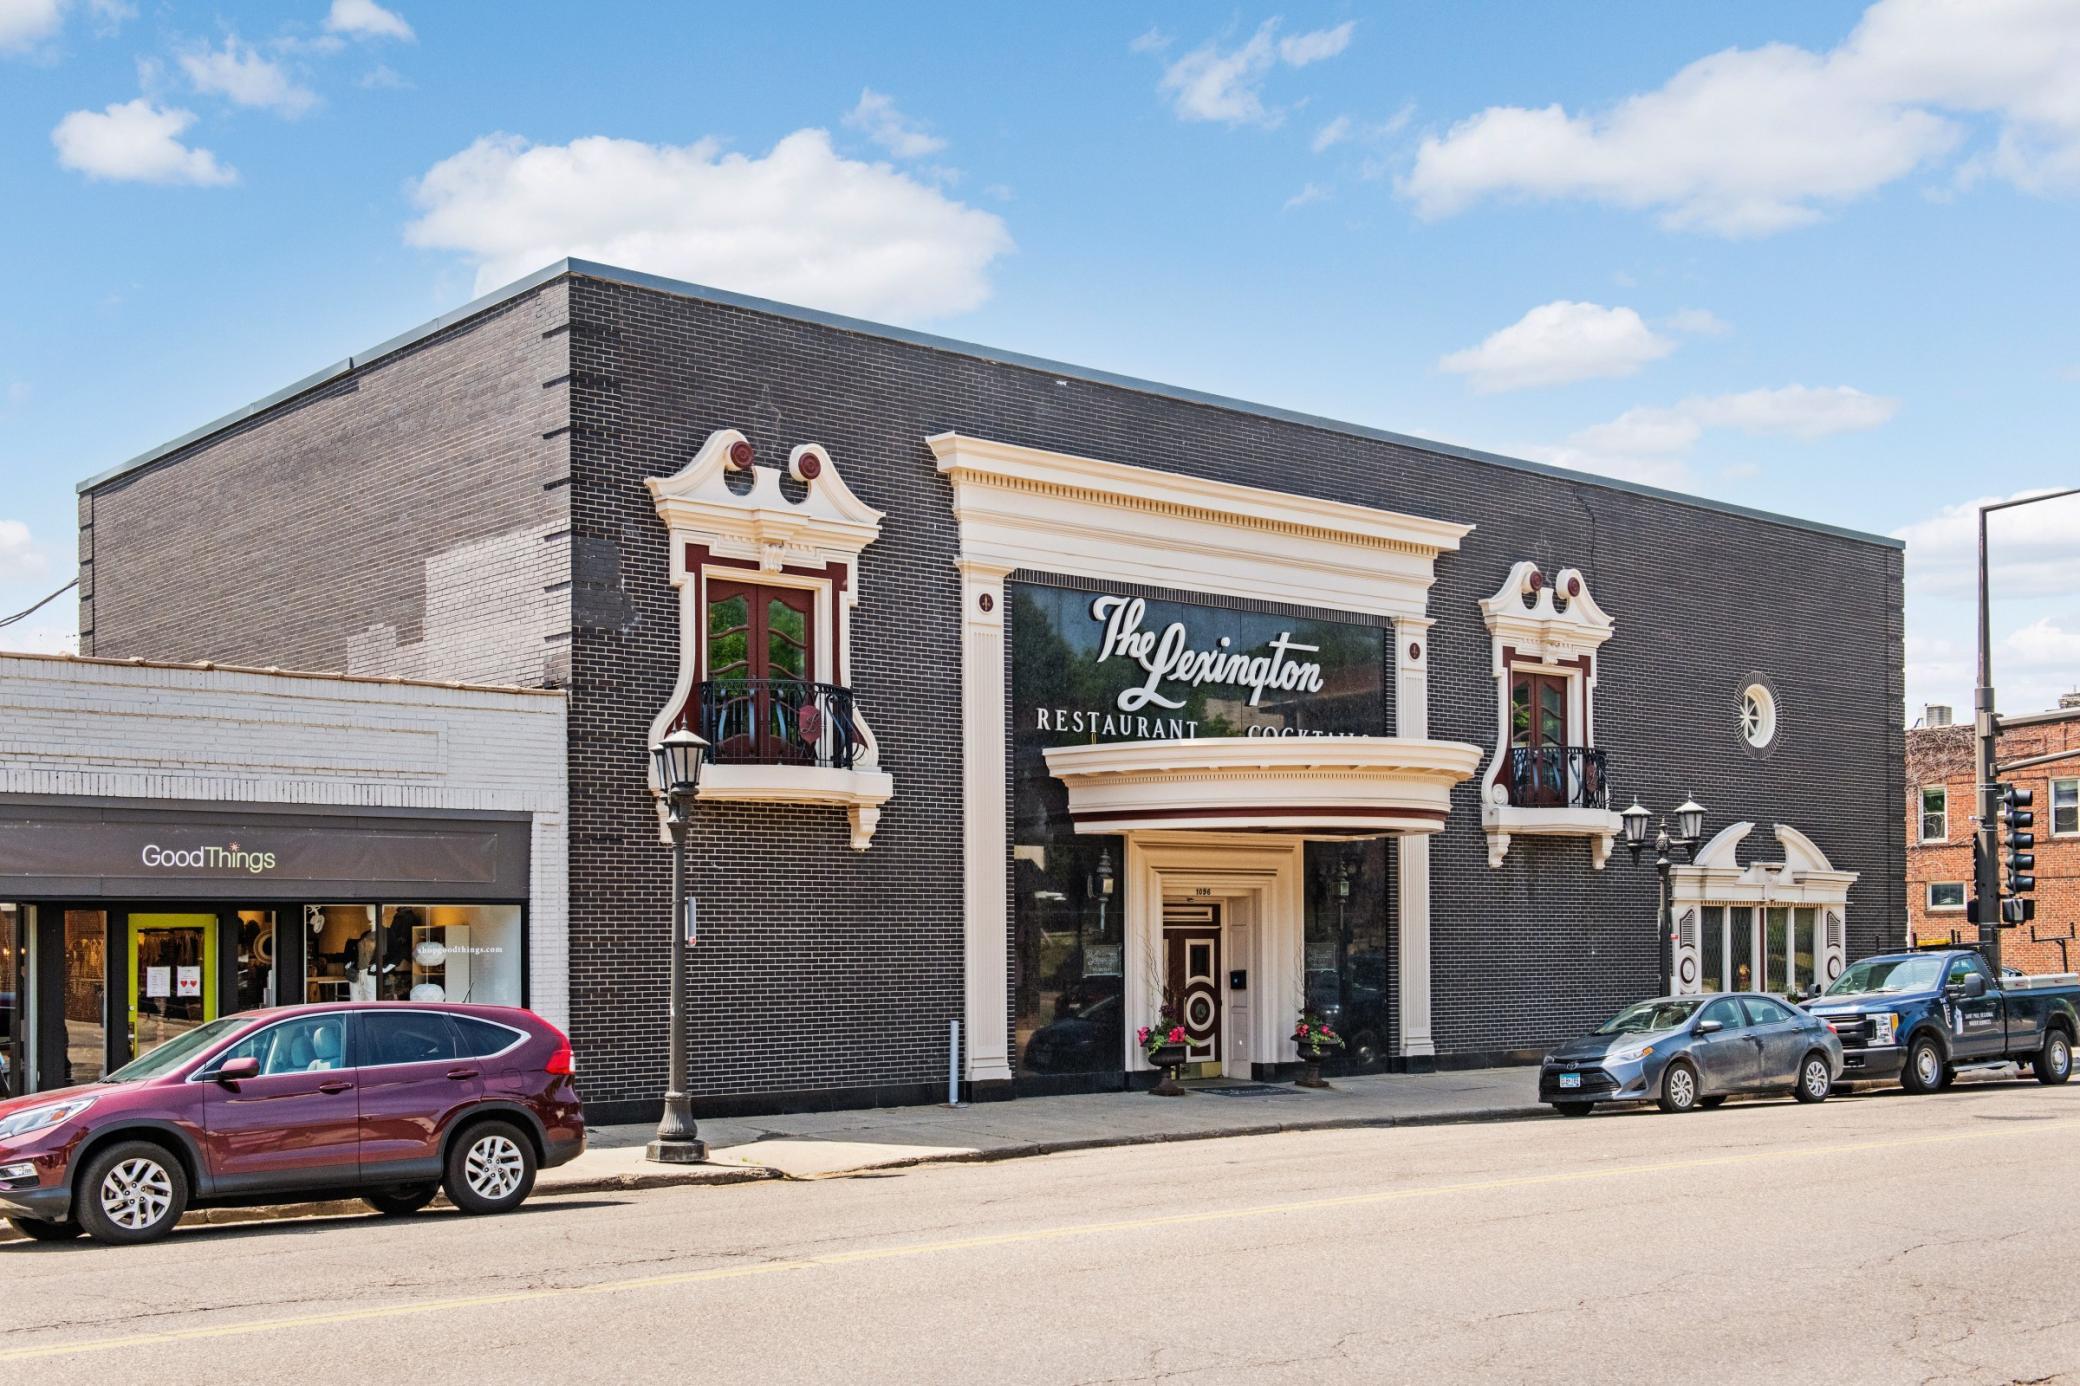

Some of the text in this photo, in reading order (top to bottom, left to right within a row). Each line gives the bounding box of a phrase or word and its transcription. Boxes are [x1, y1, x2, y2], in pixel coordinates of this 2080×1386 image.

[1093, 596, 1324, 712] The Lexington
[1036, 707, 1198, 739] RESTAURANT
[142, 841, 276, 873] GoodThings
[417, 945, 503, 954] shopgoodthings.com
